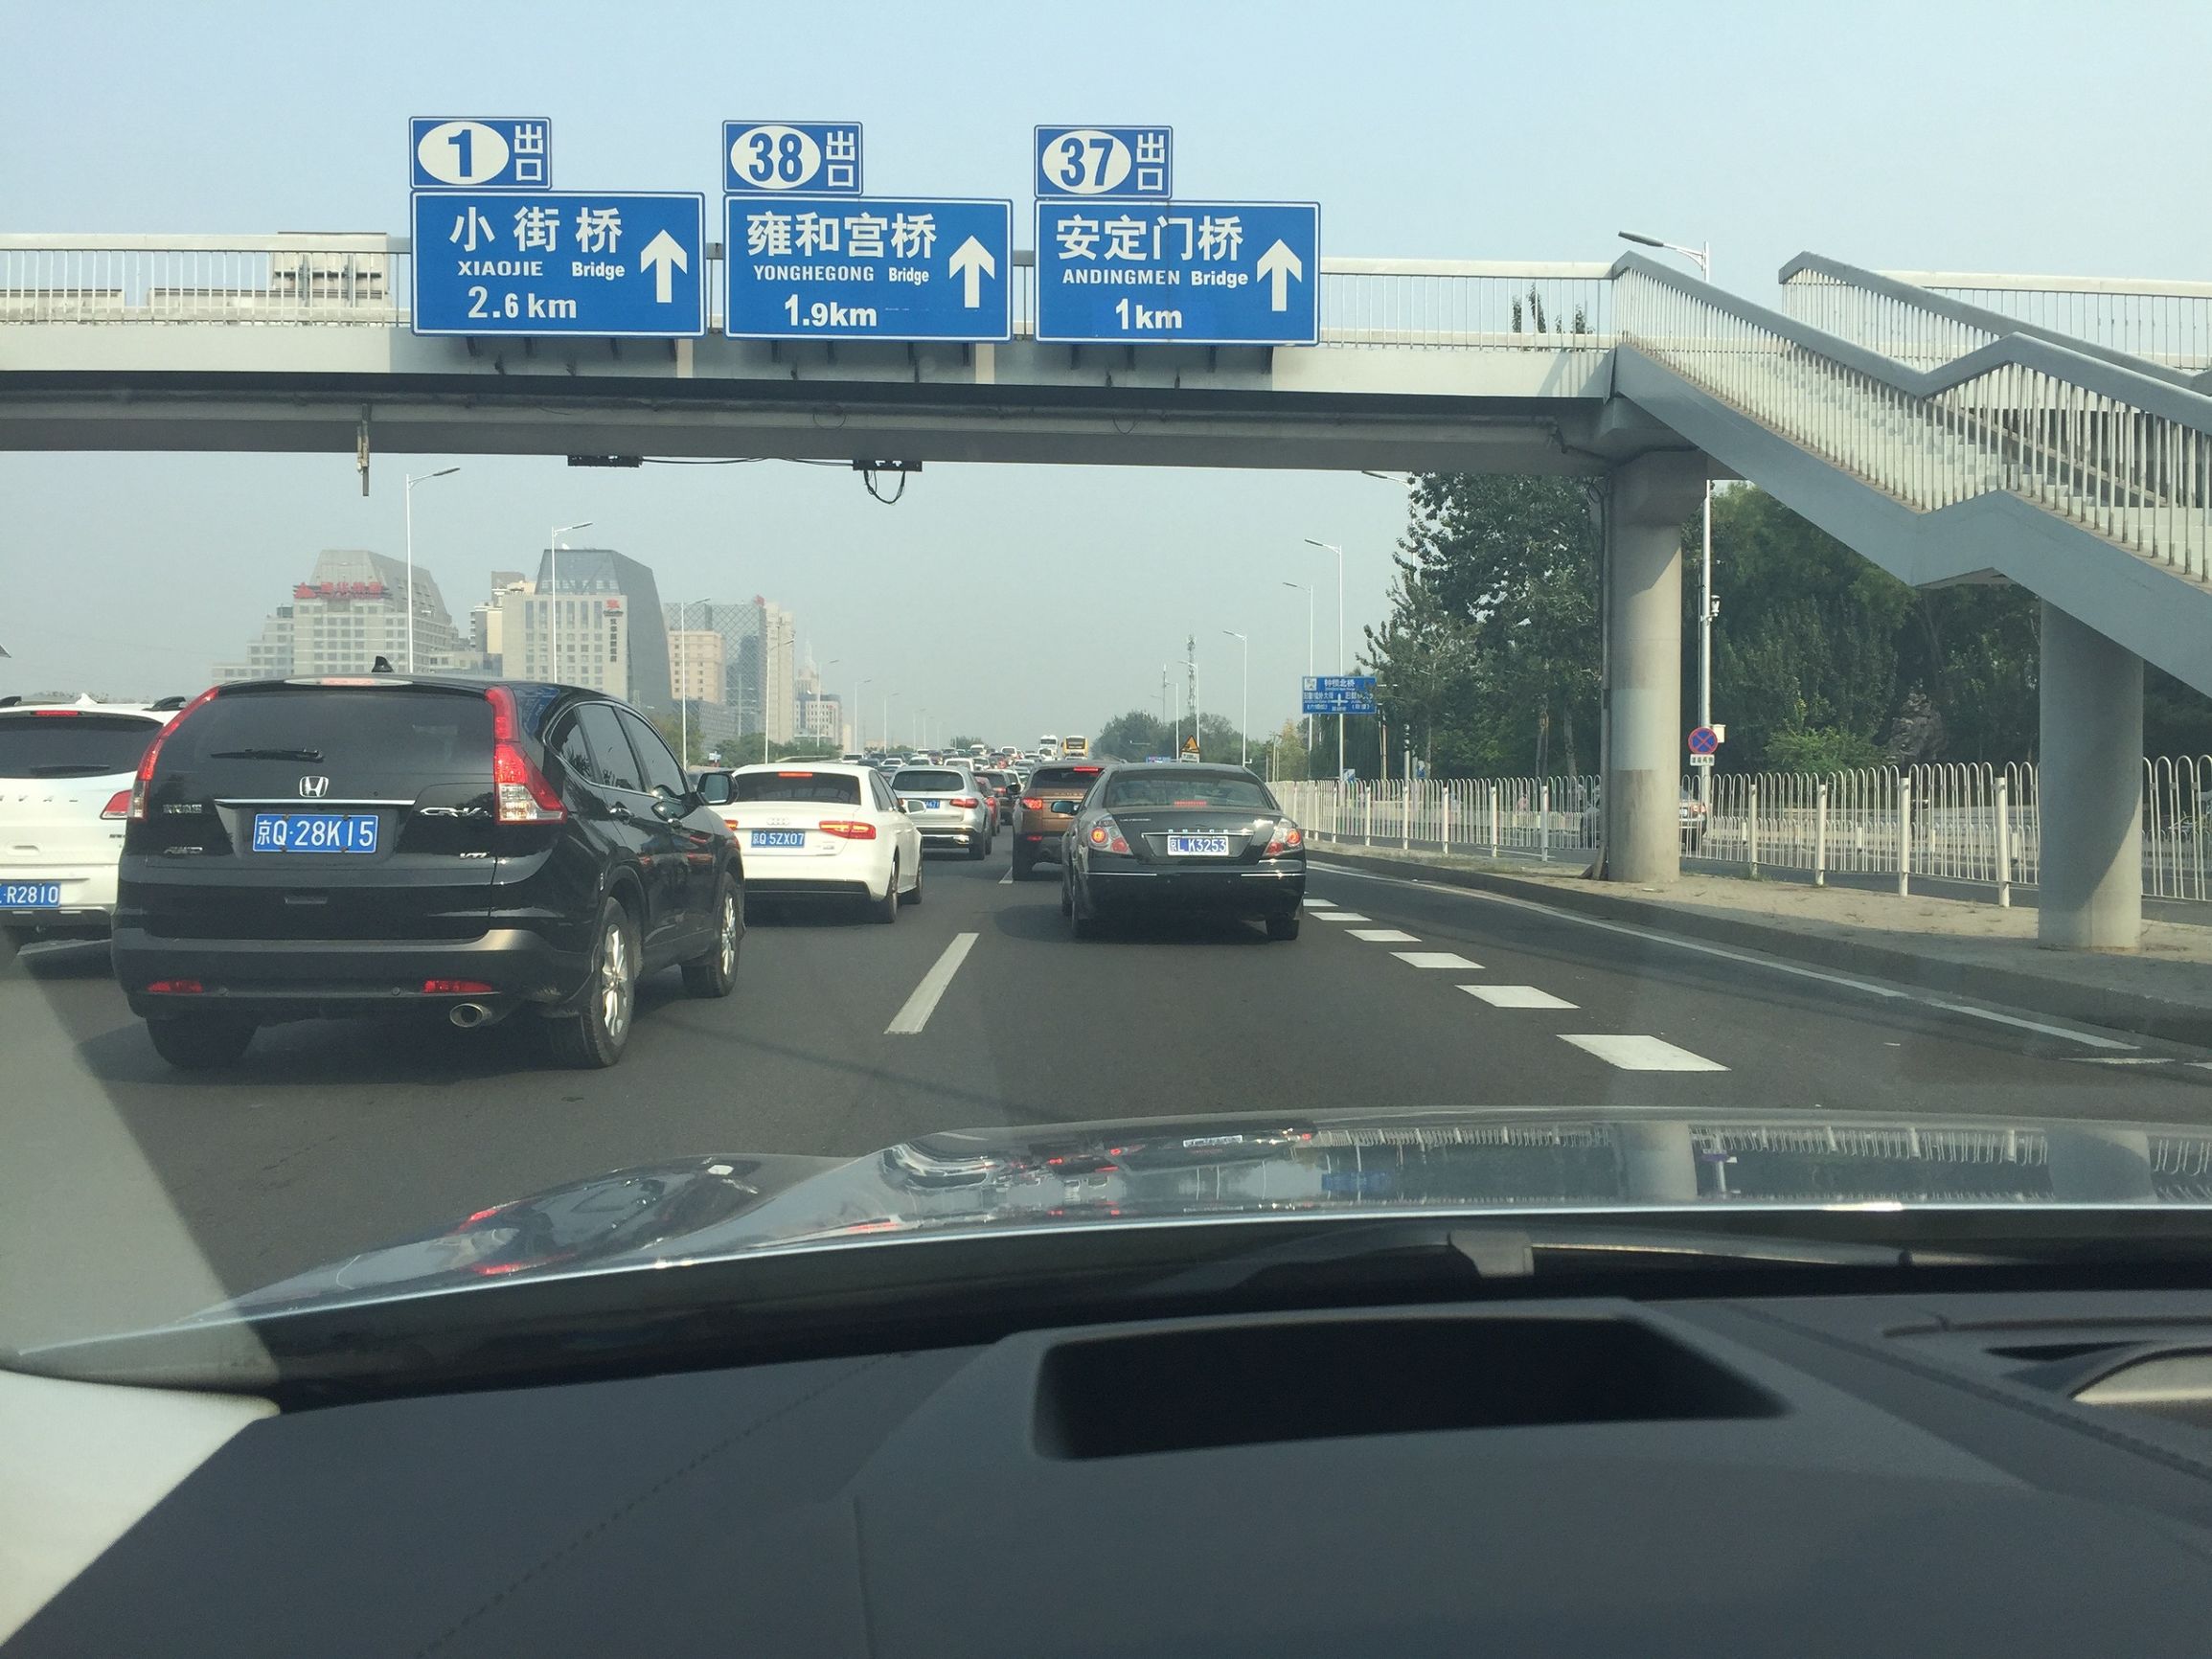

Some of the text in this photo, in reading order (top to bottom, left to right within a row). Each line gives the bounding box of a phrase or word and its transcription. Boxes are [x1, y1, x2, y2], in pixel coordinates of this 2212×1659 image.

[447, 128, 472, 177] 1
[514, 123, 544, 181] 出口
[747, 132, 804, 183] 38
[826, 130, 856, 188] 出口
[1059, 137, 1115, 187] 37
[1136, 132, 1166, 192] 出口
[746, 211, 938, 260] 雍和宫桥
[1056, 214, 1244, 262] 安定门桥
[458, 261, 626, 283] XIAOJIE Bridge
[754, 265, 930, 286] YONGHEGONG Bridge
[1062, 269, 1249, 288] ANDINGMEN Bridge
[785, 294, 878, 328] 1.9km
[1115, 298, 1183, 330] 1km
